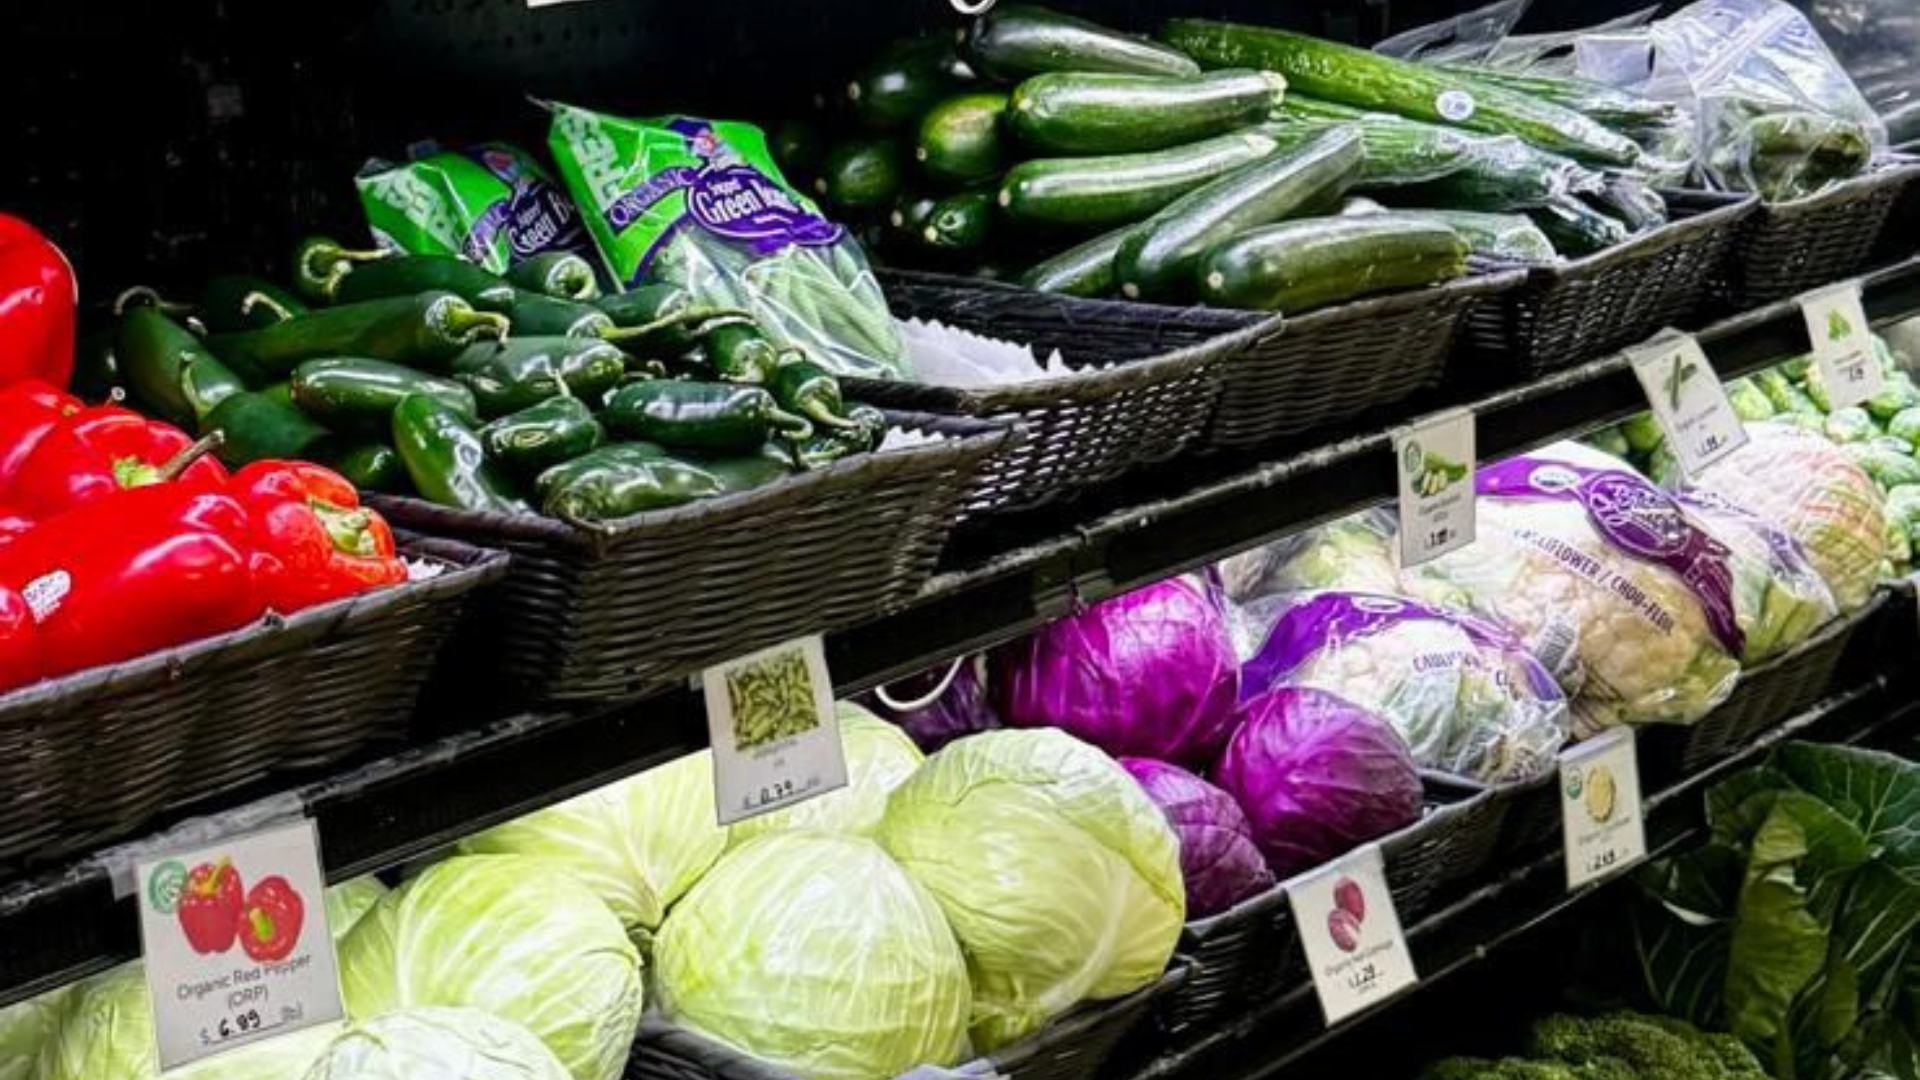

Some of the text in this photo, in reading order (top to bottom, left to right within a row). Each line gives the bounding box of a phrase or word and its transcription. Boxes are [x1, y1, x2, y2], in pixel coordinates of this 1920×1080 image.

[696, 188, 764, 224] Green
[176, 974, 232, 1000] Organic
[233, 967, 261, 984] Red
[228, 983, 268, 1010] (ORP)
